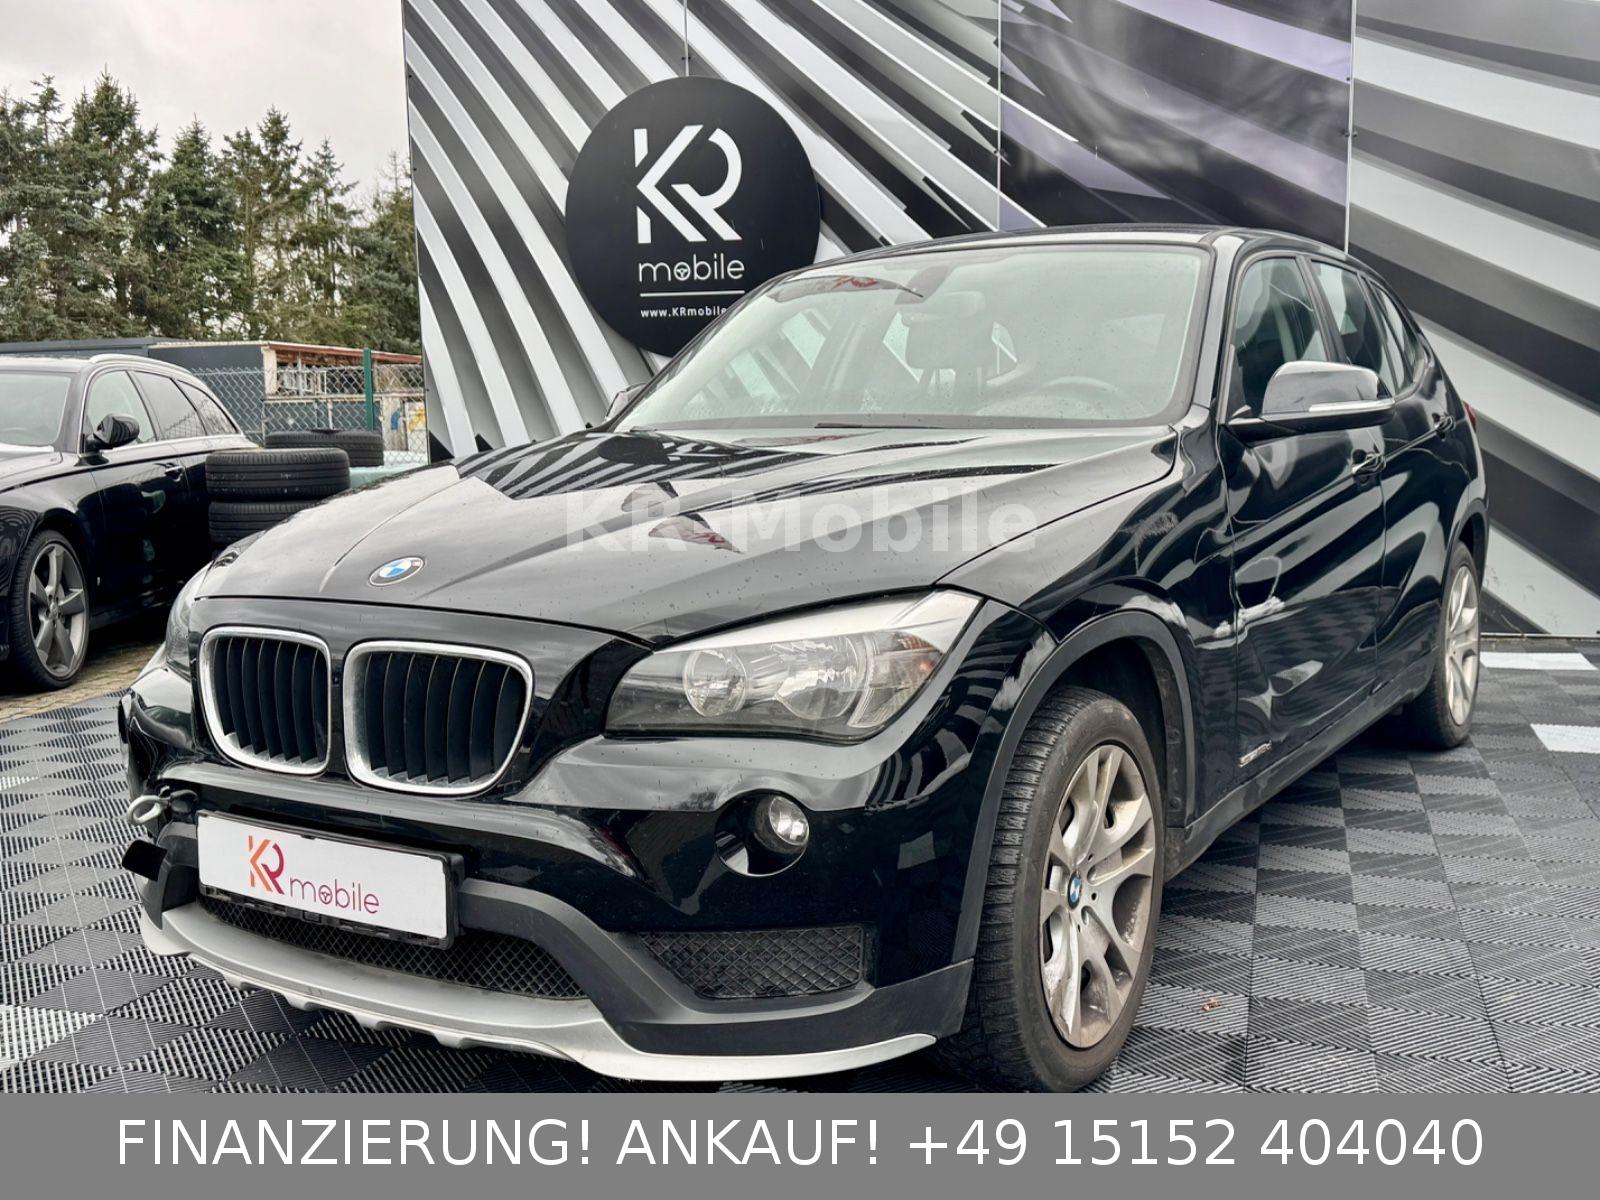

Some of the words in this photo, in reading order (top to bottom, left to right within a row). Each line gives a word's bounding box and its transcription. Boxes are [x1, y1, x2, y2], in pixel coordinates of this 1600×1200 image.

[633, 124, 743, 244] KR
[637, 252, 745, 282] mobile
[247, 835, 285, 895] KR
[289, 876, 380, 914] mobile
